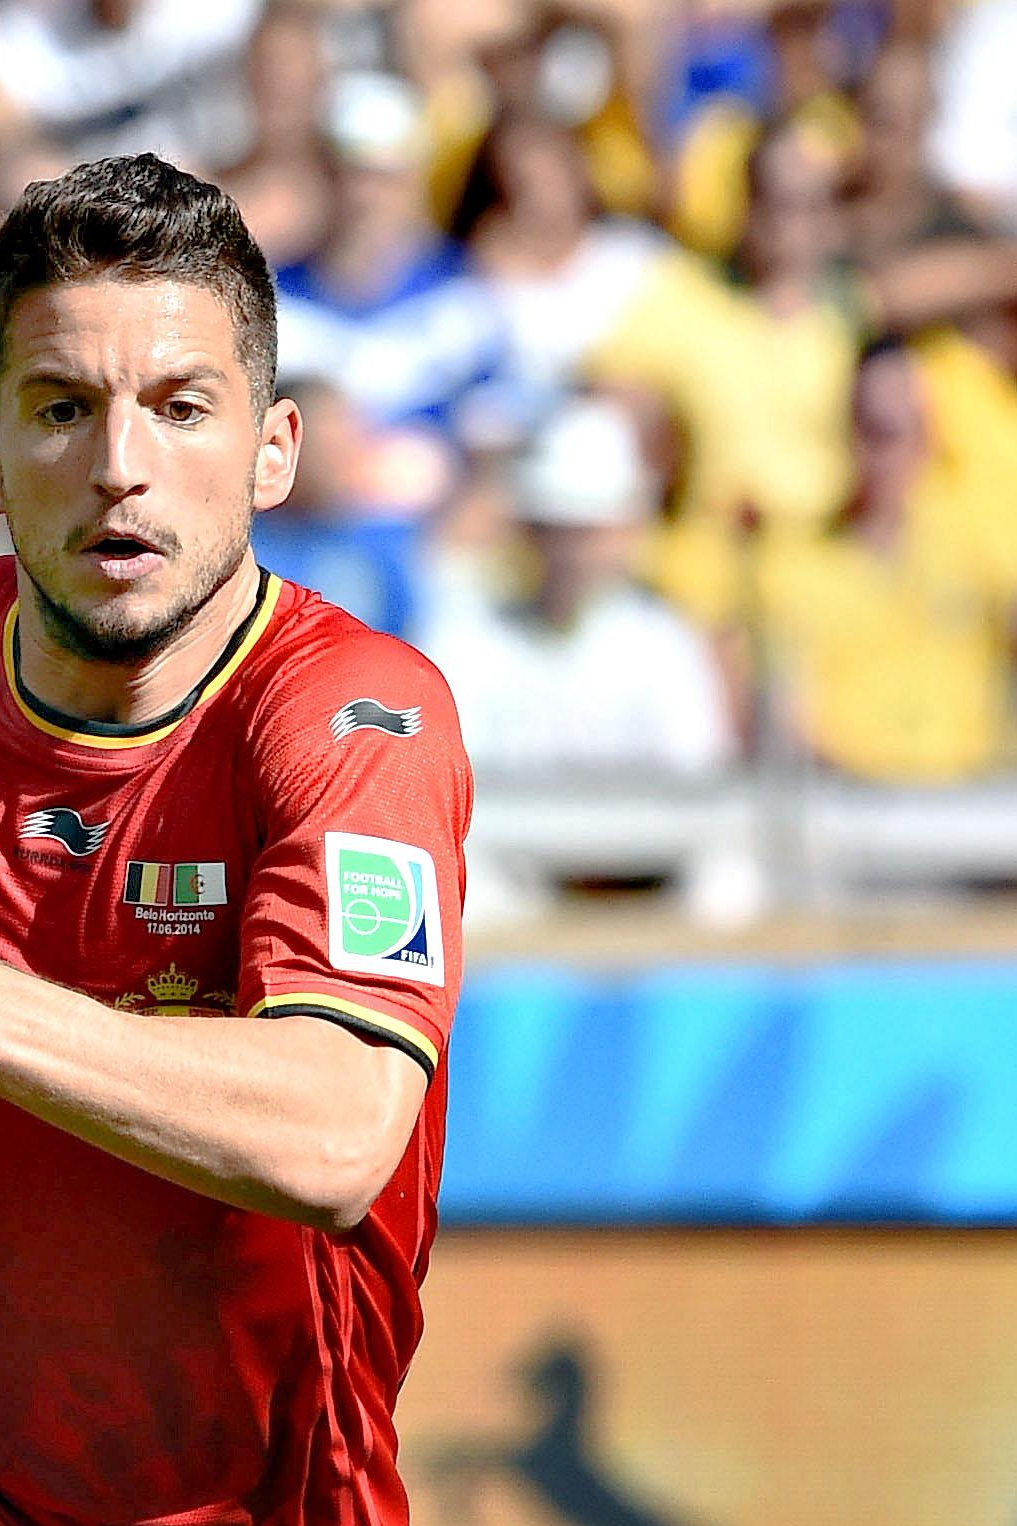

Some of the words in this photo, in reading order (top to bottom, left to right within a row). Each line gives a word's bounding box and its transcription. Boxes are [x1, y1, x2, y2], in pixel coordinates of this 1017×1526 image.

[343, 871, 402, 888] FOOTBALL
[343, 884, 369, 896] FOR
[371, 885, 402, 901] HOPE
[135, 906, 159, 920] Belo
[160, 909, 215, 921] Horizonte
[147, 922, 201, 935] 17.06.2014
[400, 949, 427, 966] FIFA
